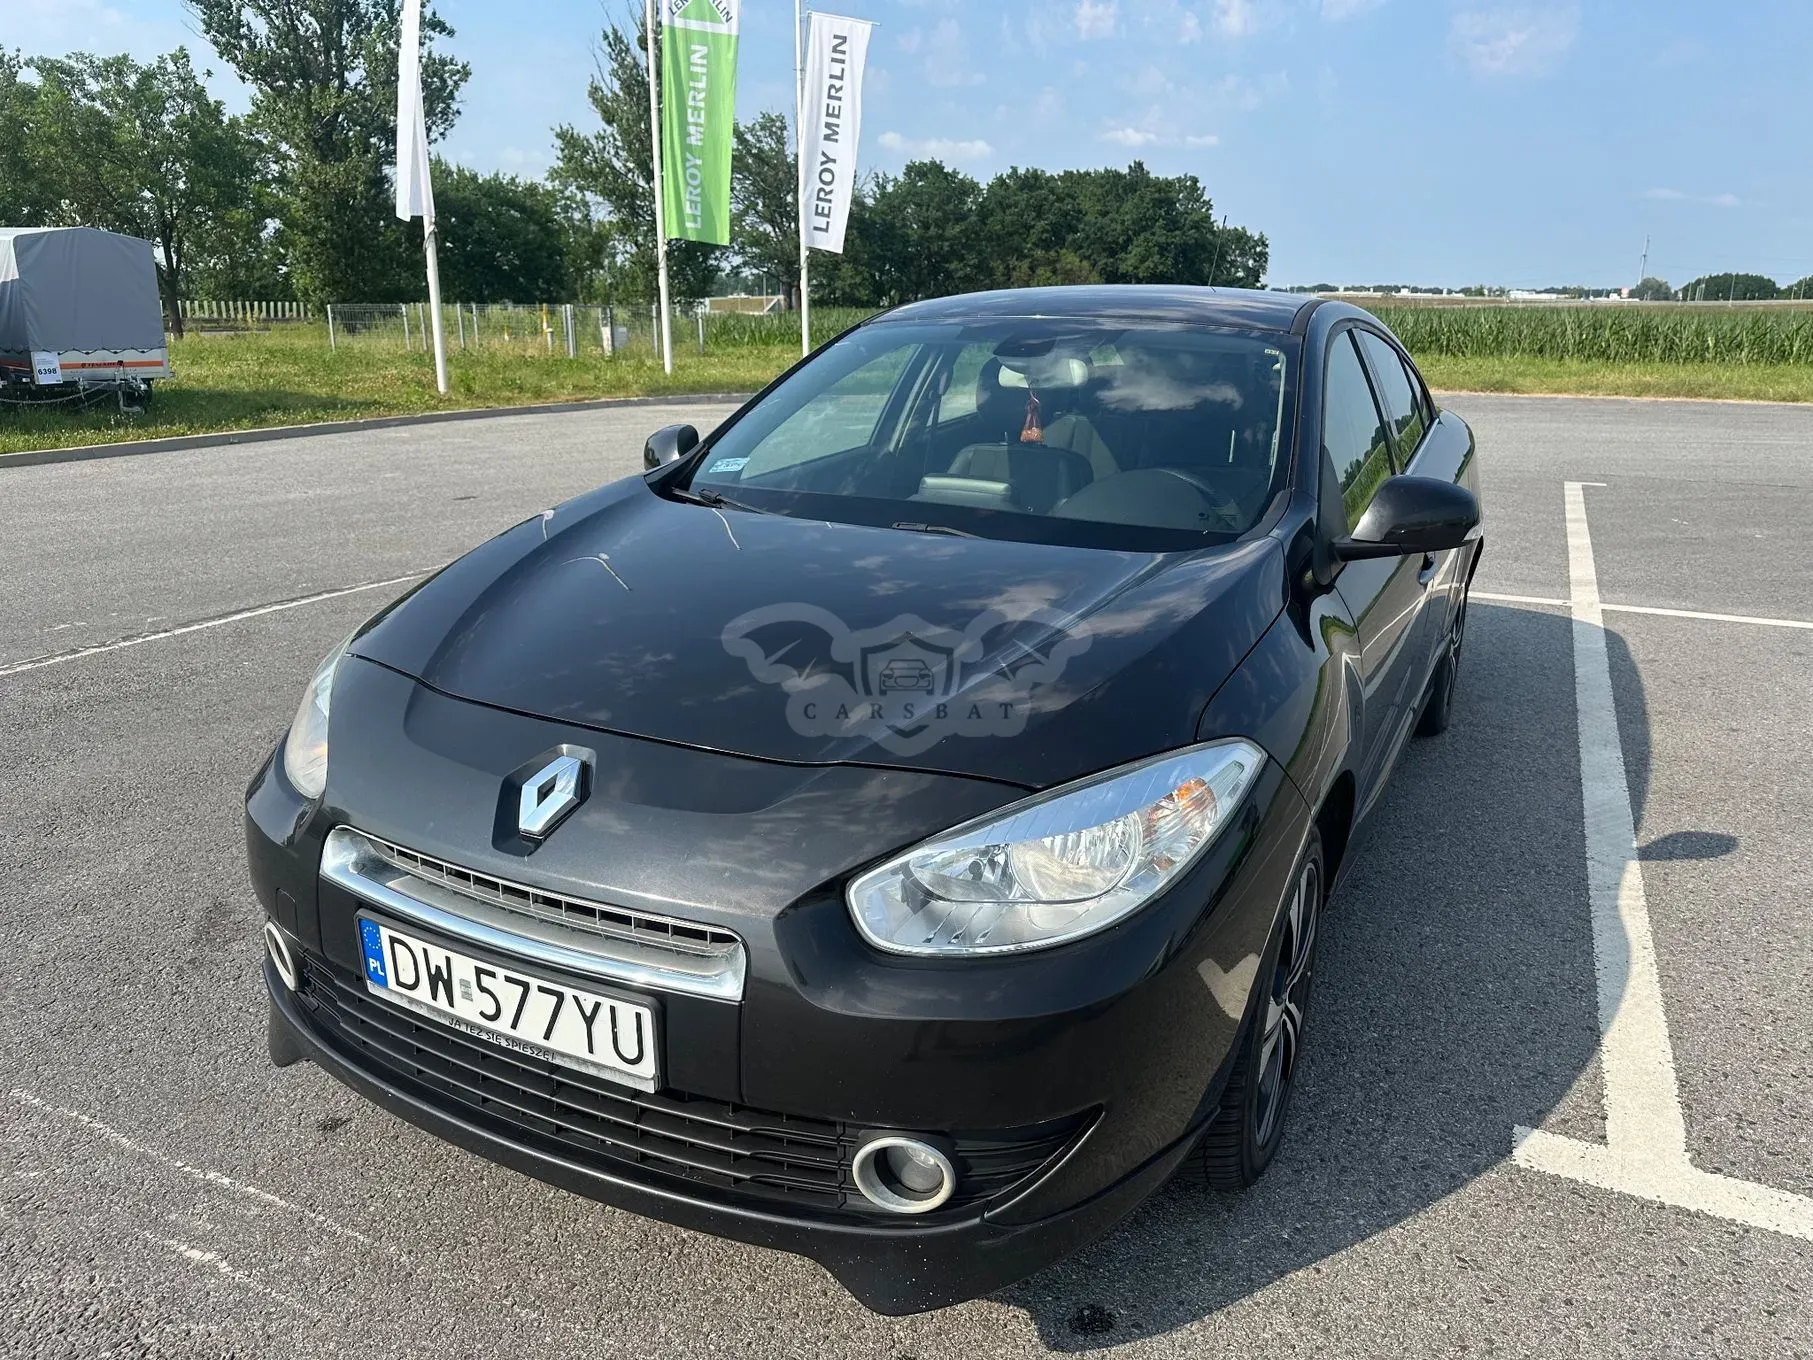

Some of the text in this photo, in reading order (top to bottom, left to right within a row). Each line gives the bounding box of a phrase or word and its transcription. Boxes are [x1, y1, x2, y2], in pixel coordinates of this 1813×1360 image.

[712, 0, 733, 23] LIN
[685, 44, 708, 229] LEROY MERLIN
[813, 33, 848, 234] LEROY MERLIN
[37, 367, 57, 376] 6398
[369, 957, 385, 977] PL
[388, 934, 645, 1066] DW 577YU
[448, 1017, 461, 1029] JA
